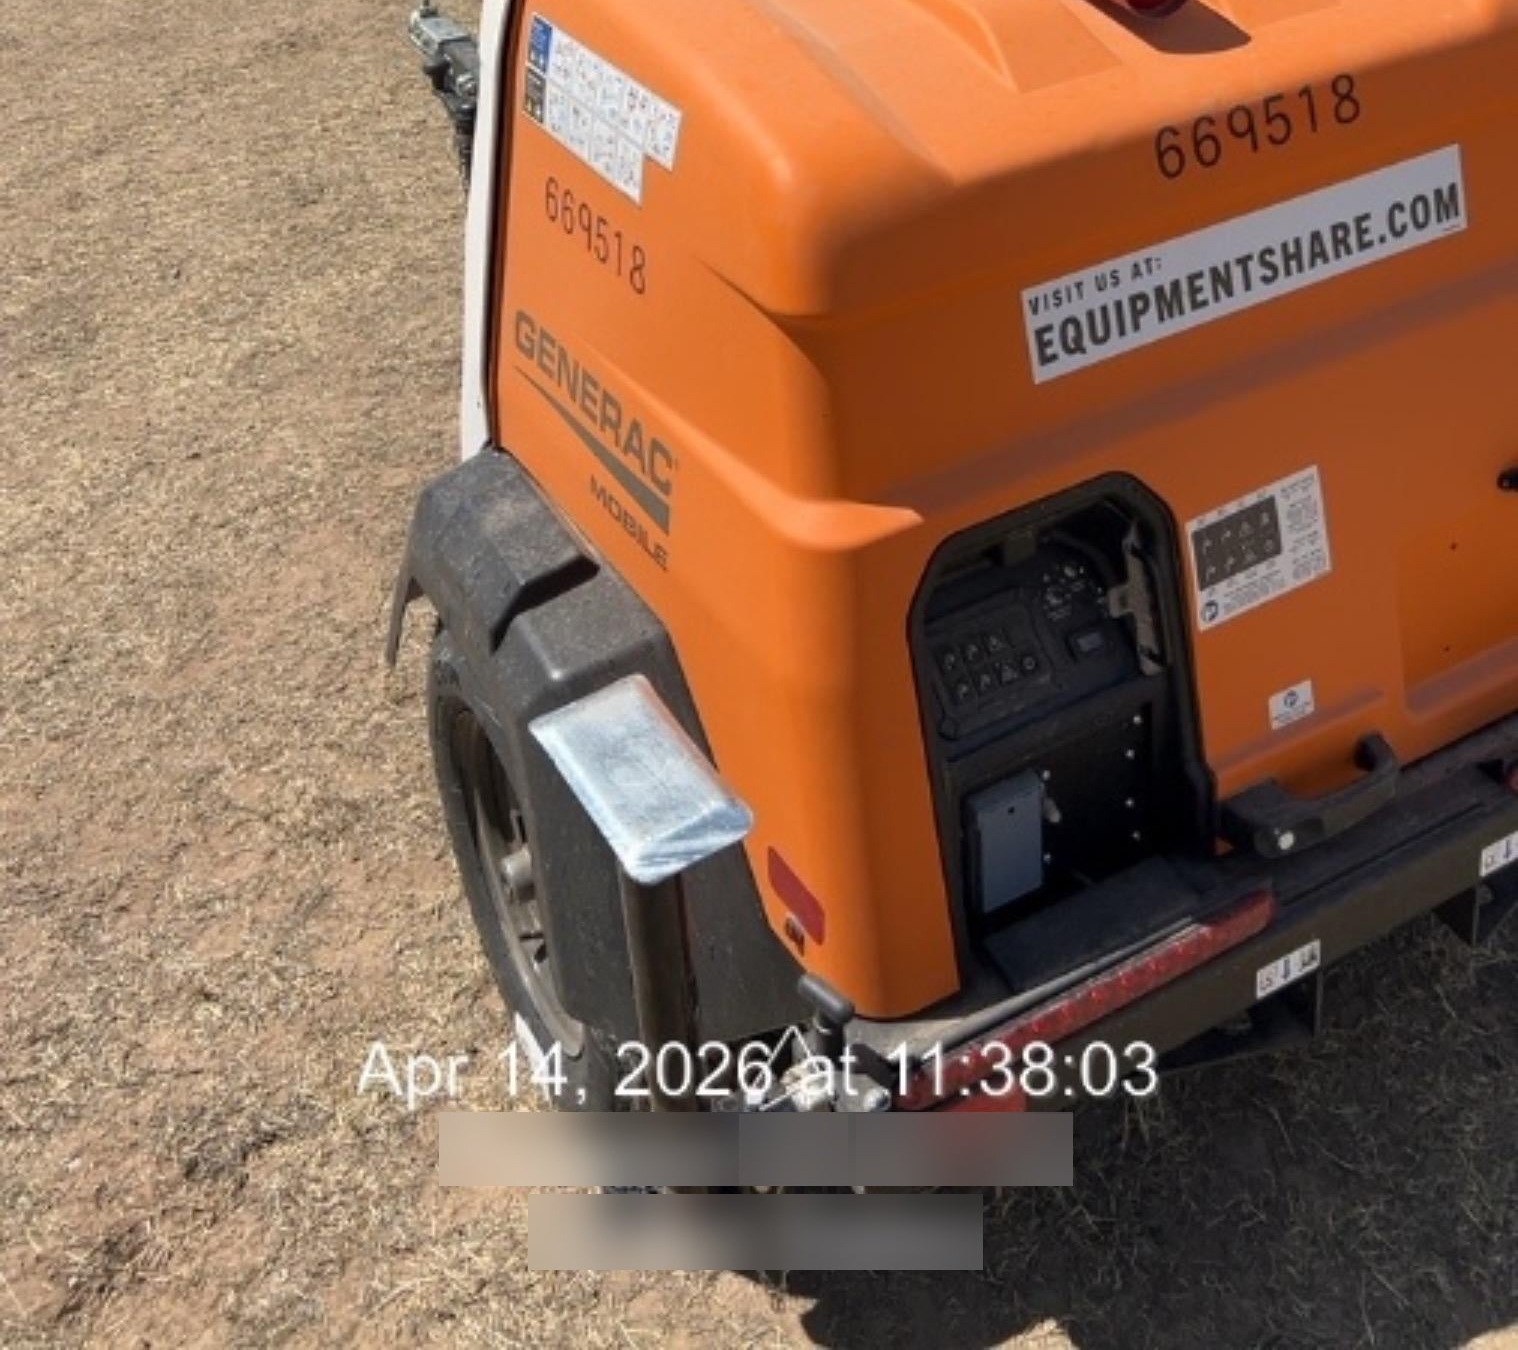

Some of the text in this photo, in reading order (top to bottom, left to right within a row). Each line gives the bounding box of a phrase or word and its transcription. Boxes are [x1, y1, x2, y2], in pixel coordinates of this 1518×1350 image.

[1155, 74, 1360, 179] 669518
[545, 176, 645, 295] 669518
[1028, 256, 1162, 316] VISIT US AT:
[1034, 182, 1460, 367] EQUIPMENTSHARE.COM
[514, 308, 673, 497] GENERAC
[590, 473, 668, 572] MOBILE
